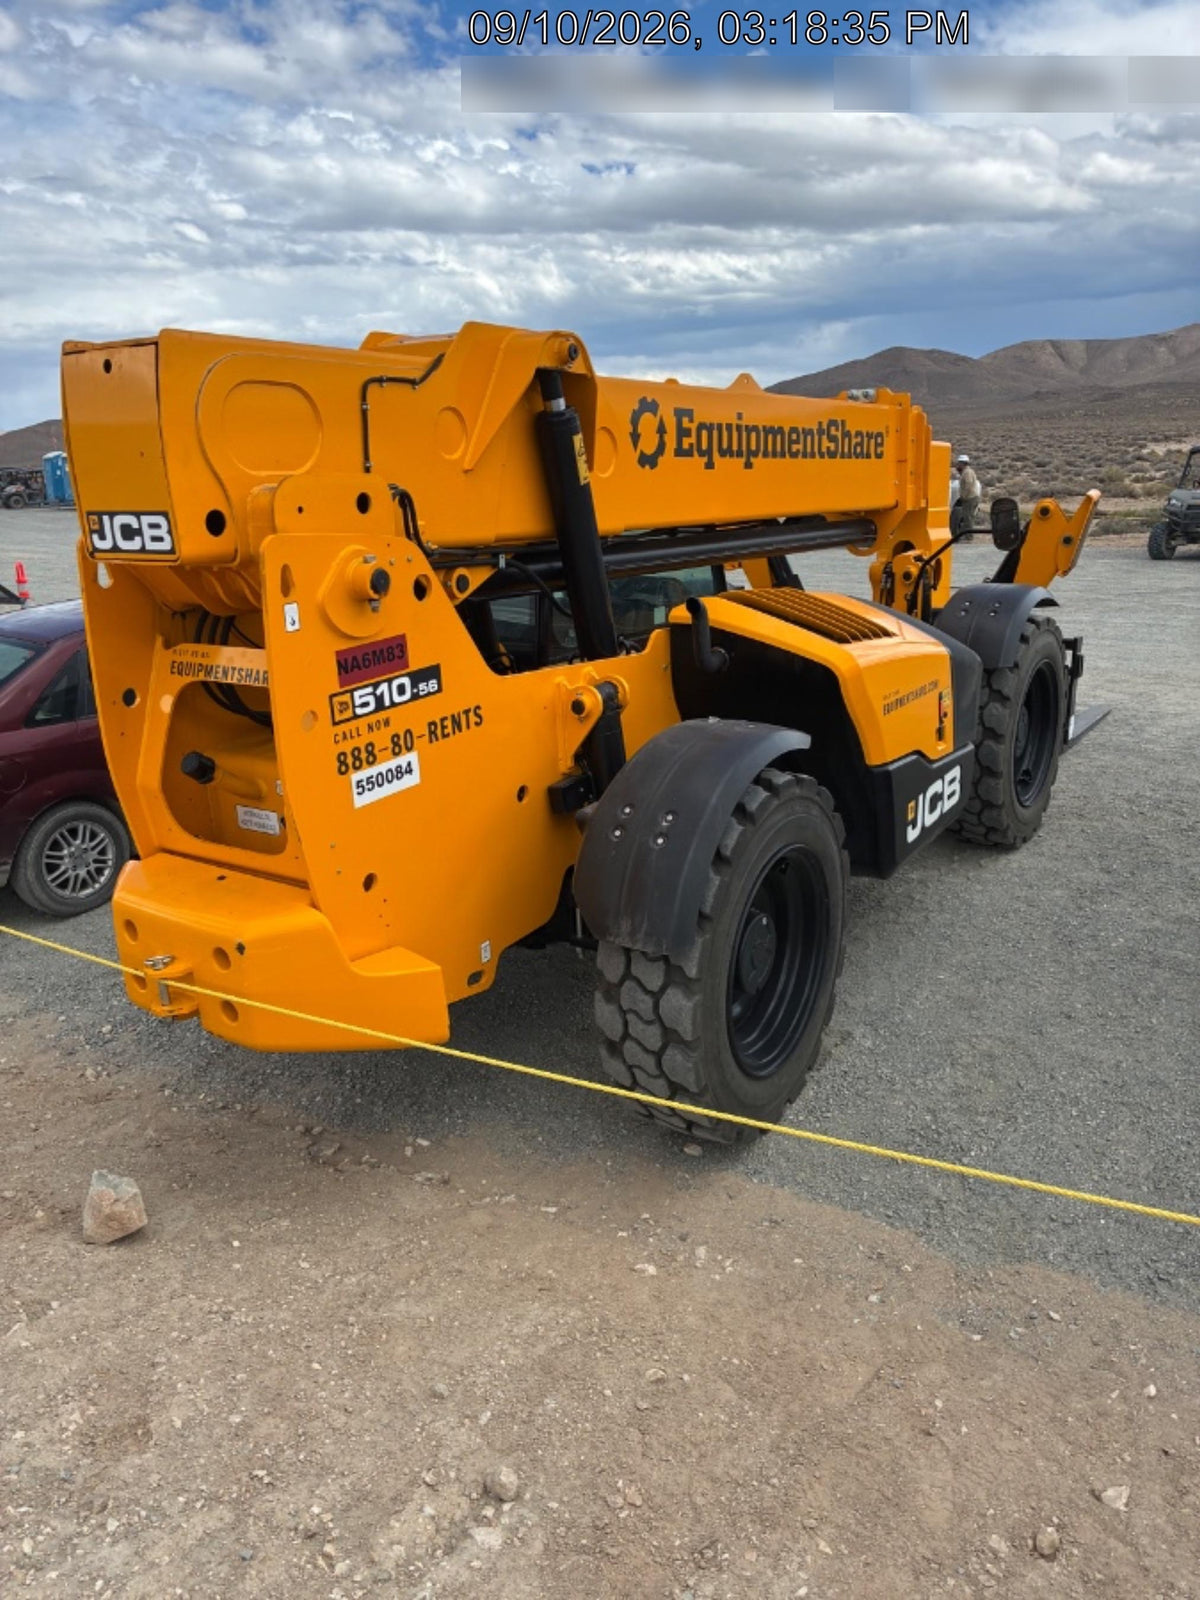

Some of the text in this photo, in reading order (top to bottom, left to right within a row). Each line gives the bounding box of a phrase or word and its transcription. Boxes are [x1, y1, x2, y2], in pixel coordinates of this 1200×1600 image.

[673, 407, 885, 470] EquipmentShare
[91, 514, 173, 551] JCB
[170, 660, 268, 687] EQUIPMENTSHAR
[337, 642, 405, 676] NA6M83
[334, 716, 391, 745] CALL NOW
[336, 705, 483, 775] 888-80-RENTS
[355, 760, 413, 796] 550084
[906, 764, 961, 843] JCB
